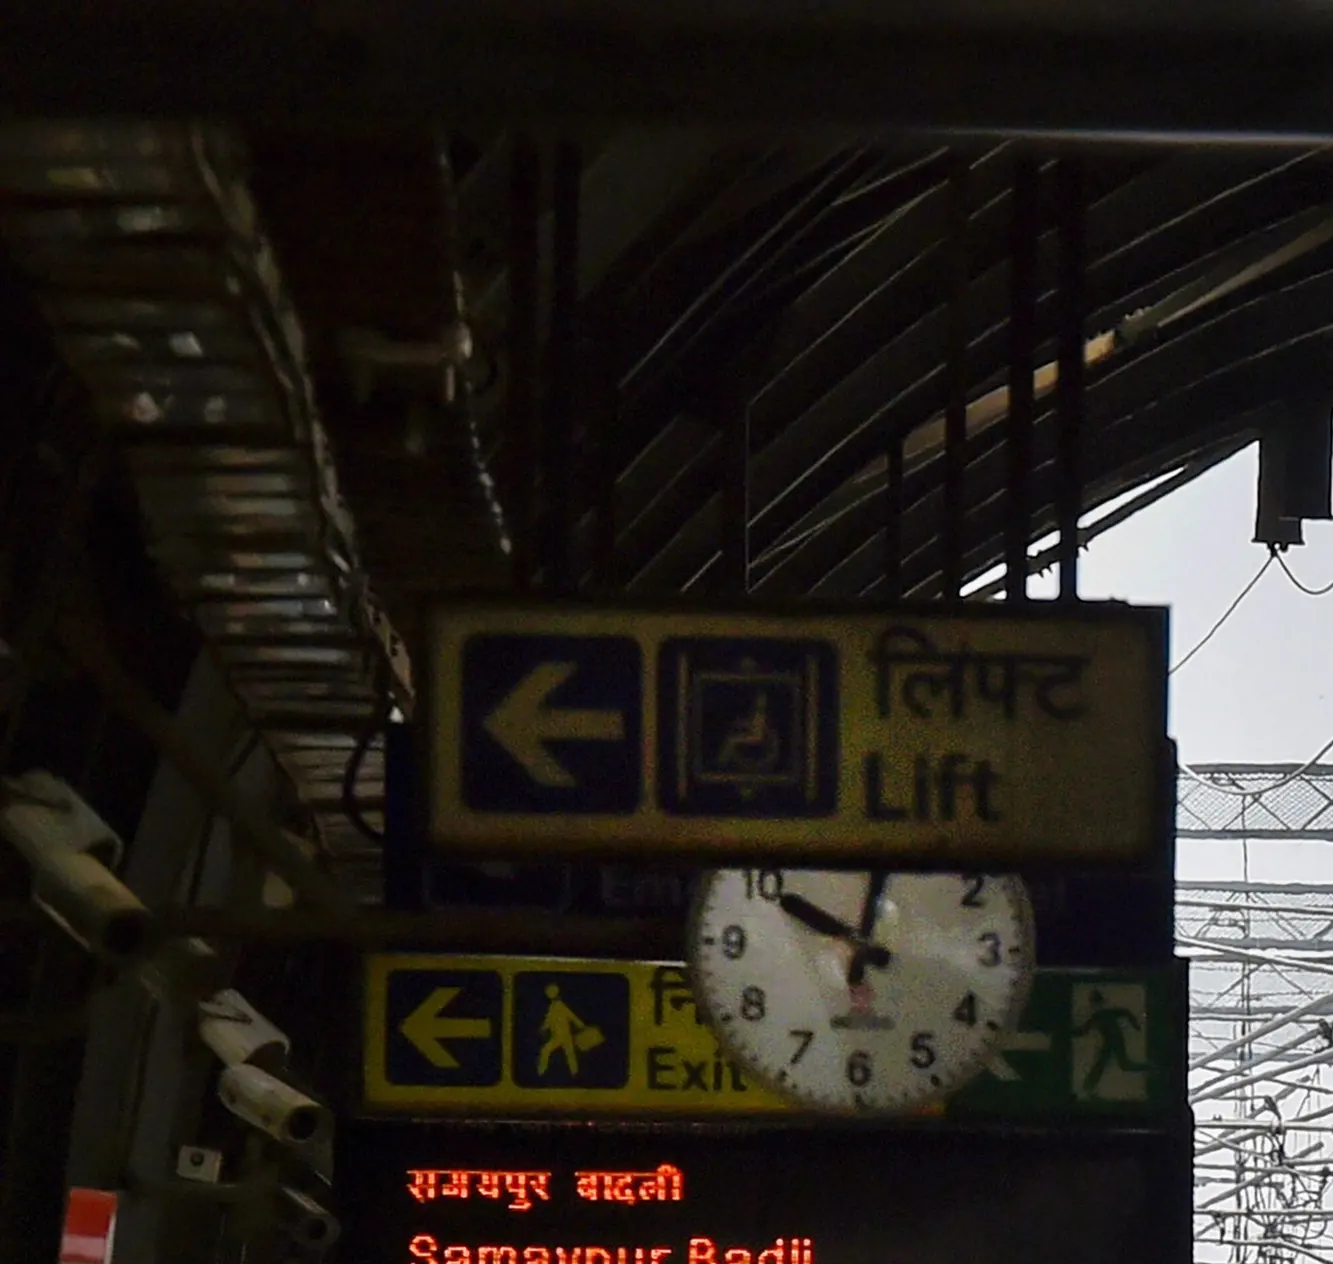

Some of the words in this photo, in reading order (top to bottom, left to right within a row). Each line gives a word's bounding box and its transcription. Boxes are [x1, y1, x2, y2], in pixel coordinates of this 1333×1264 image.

[865, 752, 1002, 822] Lift
[743, 868, 783, 901] 10
[961, 873, 984, 906] 2
[722, 924, 746, 959] 9
[976, 932, 1000, 967] 3
[741, 985, 766, 1021] 8
[953, 992, 977, 1026] 4
[790, 1030, 813, 1064] 7
[911, 1033, 935, 1068] 5
[647, 1047, 747, 1092] Exit
[847, 1050, 871, 1086] 6
